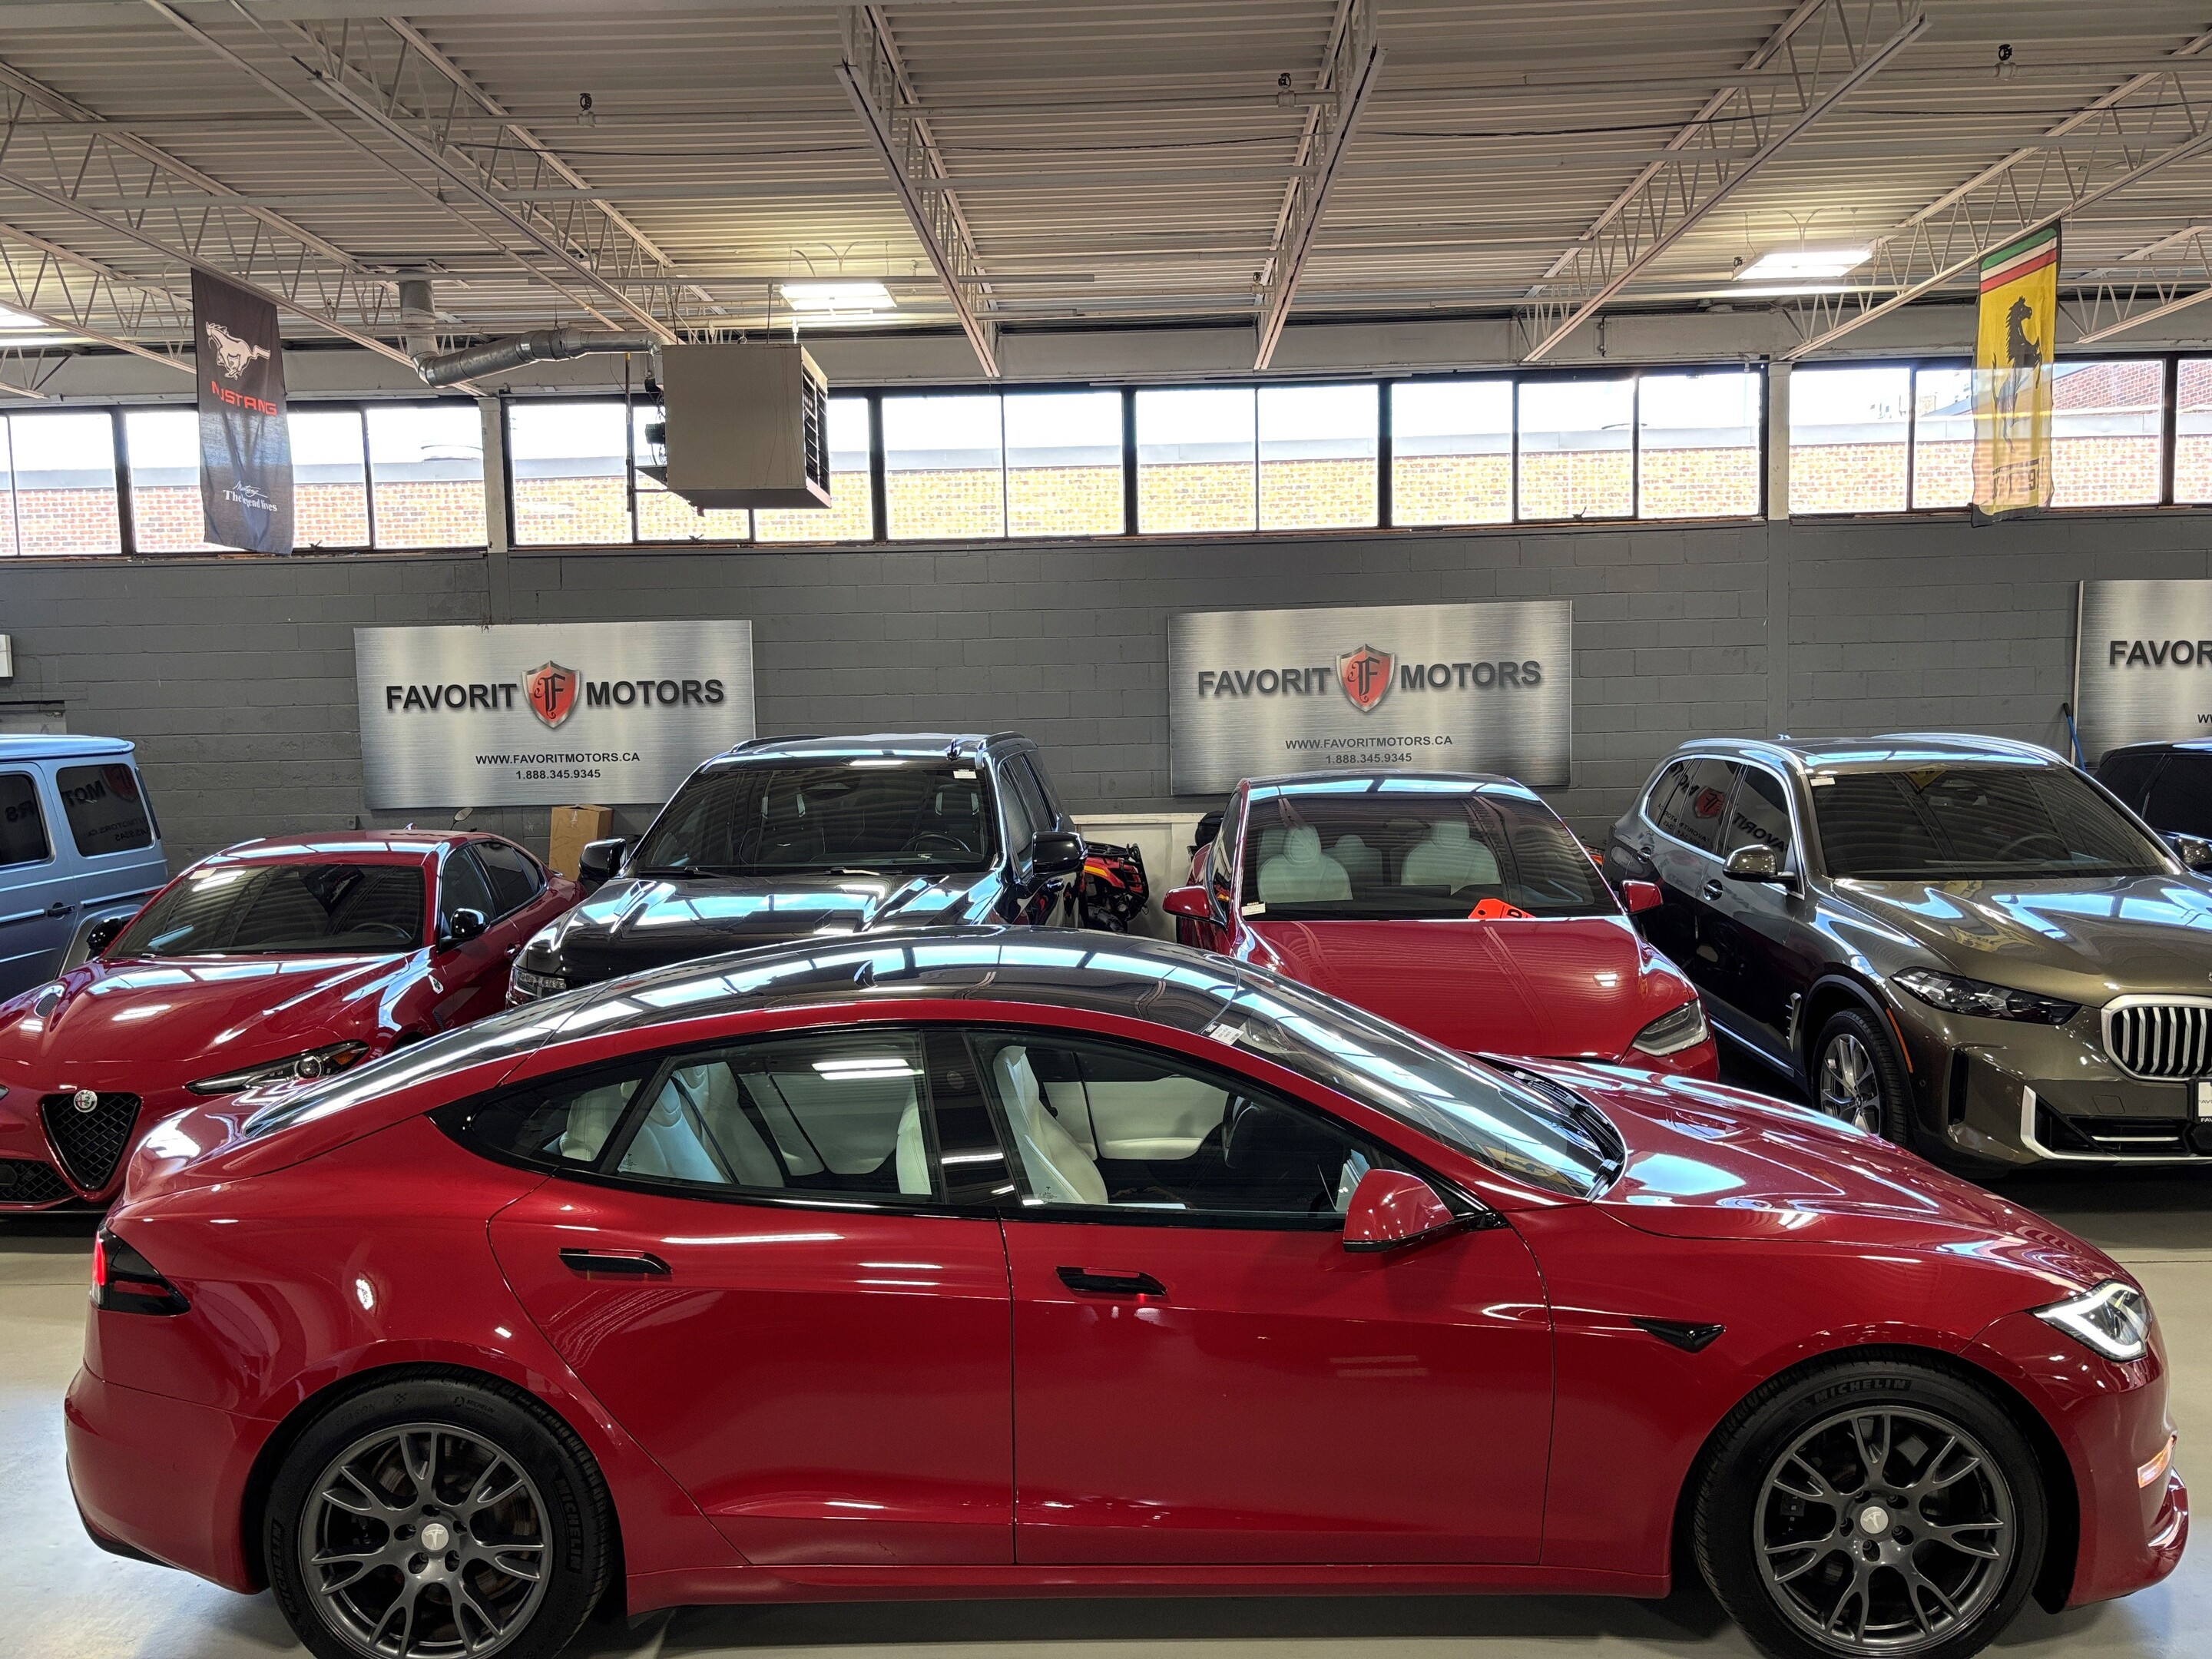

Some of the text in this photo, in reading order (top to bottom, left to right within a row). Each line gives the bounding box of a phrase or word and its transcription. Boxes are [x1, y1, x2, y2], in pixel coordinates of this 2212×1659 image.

[223, 489, 242, 502] The
[260, 499, 278, 512] lives
[1197, 667, 1330, 696] FAVORIT
[1400, 661, 1541, 689] MOTORS
[386, 683, 517, 710] FAVORIT
[586, 679, 724, 707] MOTORS
[1285, 735, 1452, 750] WWW.FAVORITMOTORS.CA
[475, 751, 640, 765] WWW.FAVORITMOTORS.CA
[1325, 753, 1412, 764] 1.888.345.9345
[515, 769, 601, 780] 1.888.345.9345
[1814, 1379, 1908, 1403] MICHELIN
